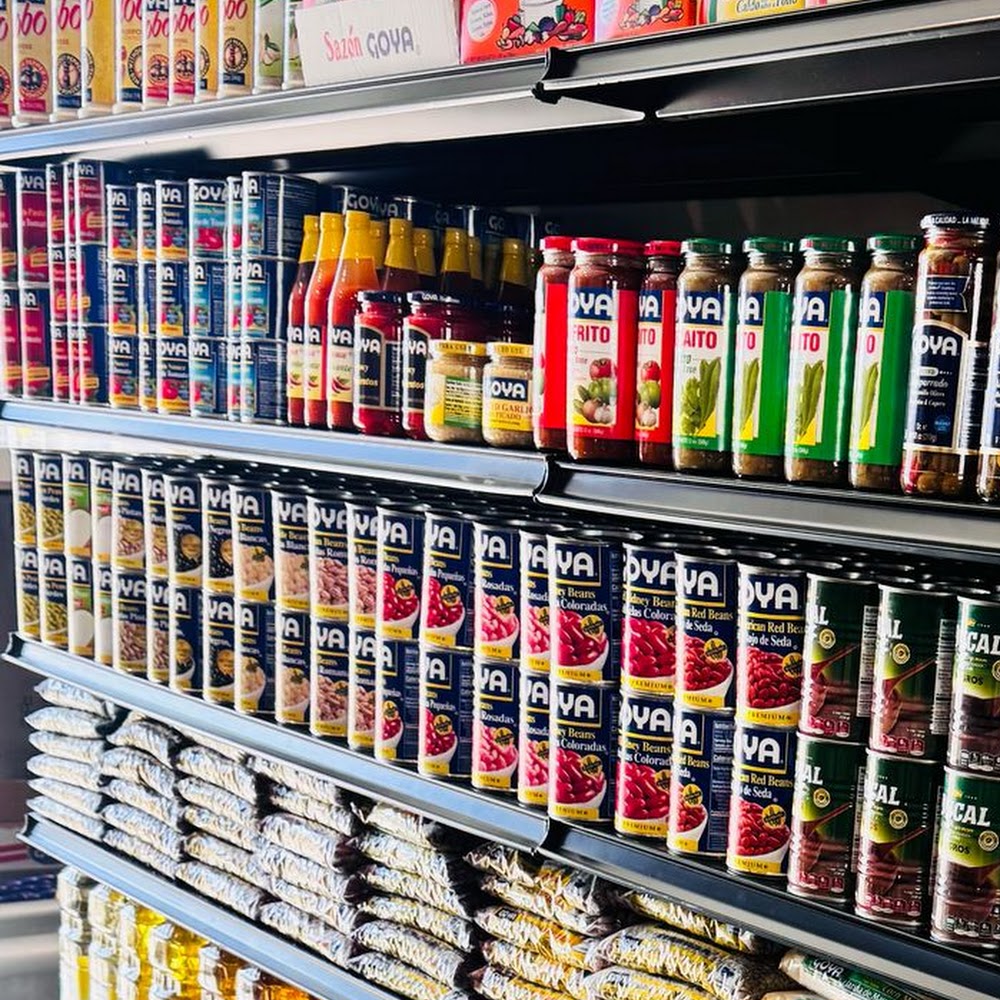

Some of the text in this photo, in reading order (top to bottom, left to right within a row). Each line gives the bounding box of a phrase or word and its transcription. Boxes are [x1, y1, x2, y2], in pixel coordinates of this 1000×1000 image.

[367, 24, 414, 60] GOYA
[491, 381, 525, 399] OYA
[568, 588, 596, 599] Beans
[561, 599, 608, 613] Coloradas
[691, 608, 733, 620] Red Beans
[694, 621, 714, 634] Seda
[767, 622, 783, 633] Red
[771, 636, 792, 647] Seda
[567, 728, 596, 739] Beans
[640, 740, 672, 754] Beans
[686, 756, 710, 769] Beans
[750, 772, 793, 788] Red Beans
[752, 785, 774, 799] Seda
[812, 959, 844, 977] GOYA
